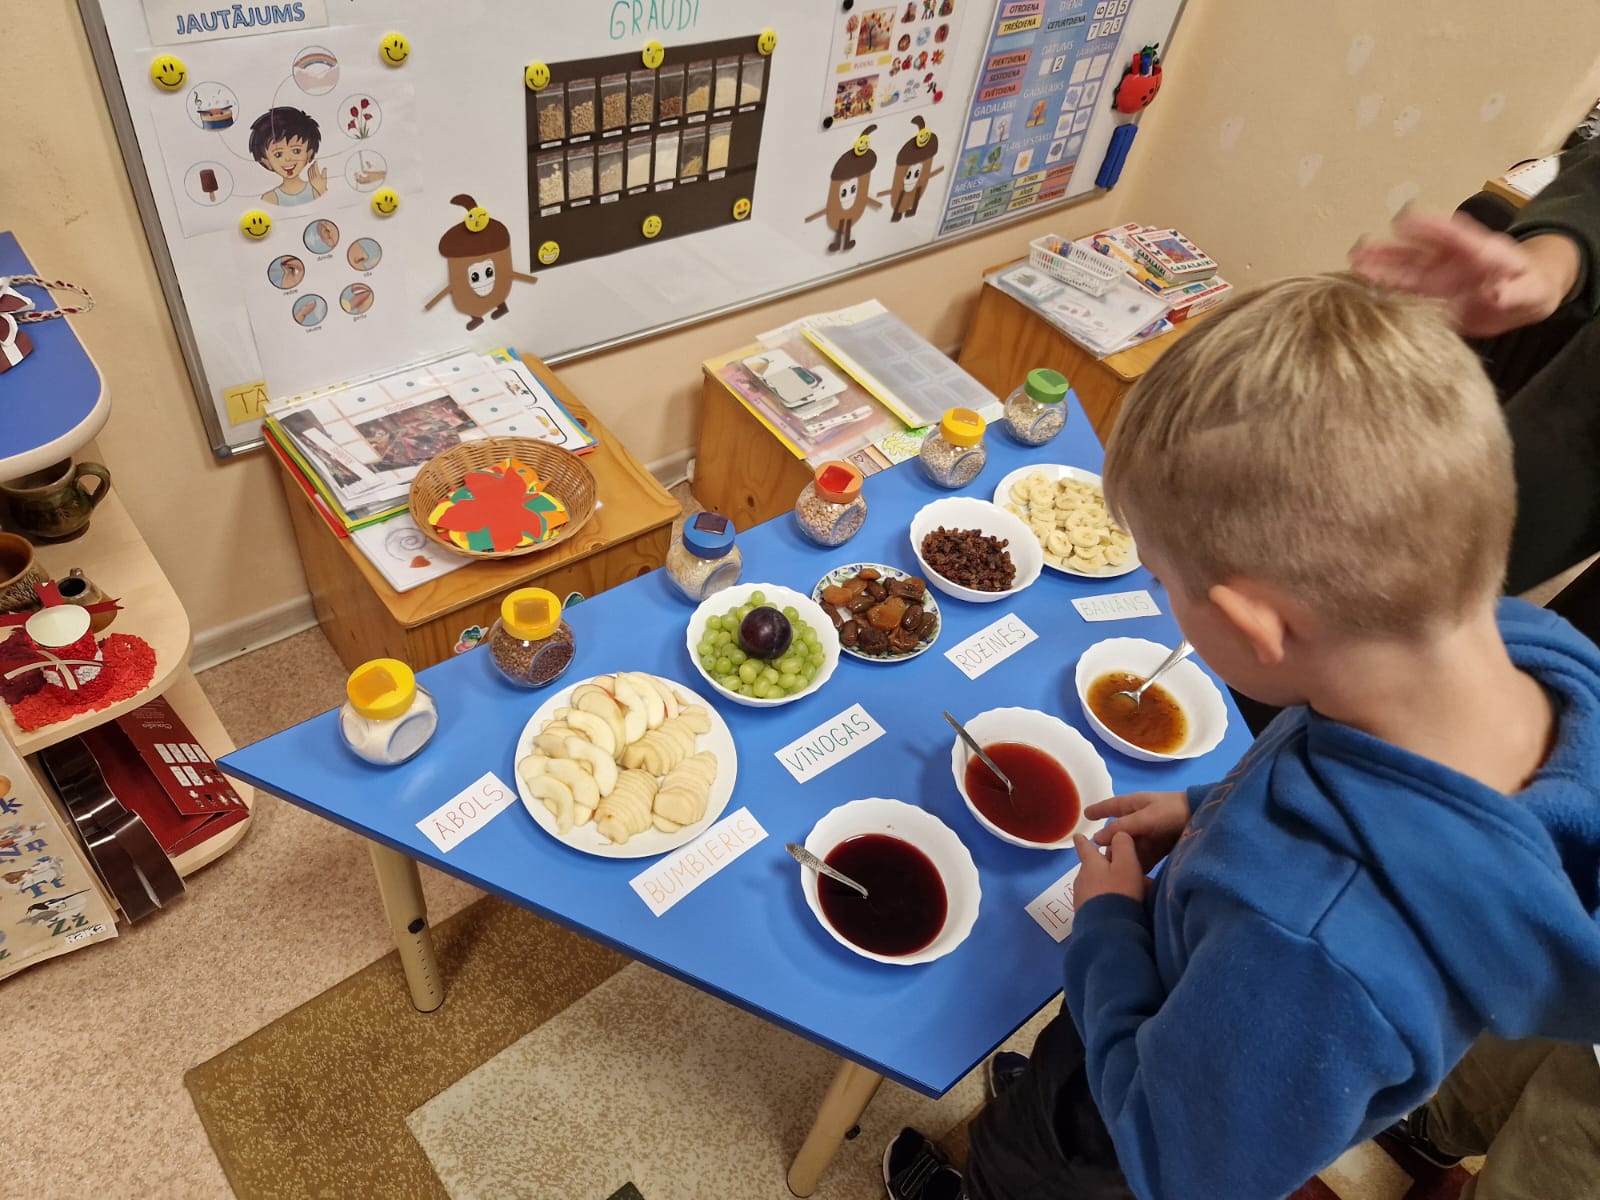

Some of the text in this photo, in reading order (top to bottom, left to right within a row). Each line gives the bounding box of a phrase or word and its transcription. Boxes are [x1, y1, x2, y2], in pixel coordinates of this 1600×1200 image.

[176, 2, 306, 35] JAUTĀJUMS
[609, 0, 699, 40] GRAUDI
[1009, 3, 1040, 14] OTRDIENA
[1055, 57, 1063, 69] 2
[230, 384, 270, 415] TĀ
[955, 621, 1028, 672] ROŽĪNES
[785, 712, 870, 773] VĪNOGAS
[434, 782, 504, 841] ĀBOLS
[643, 818, 757, 904] BUMBIERIS
